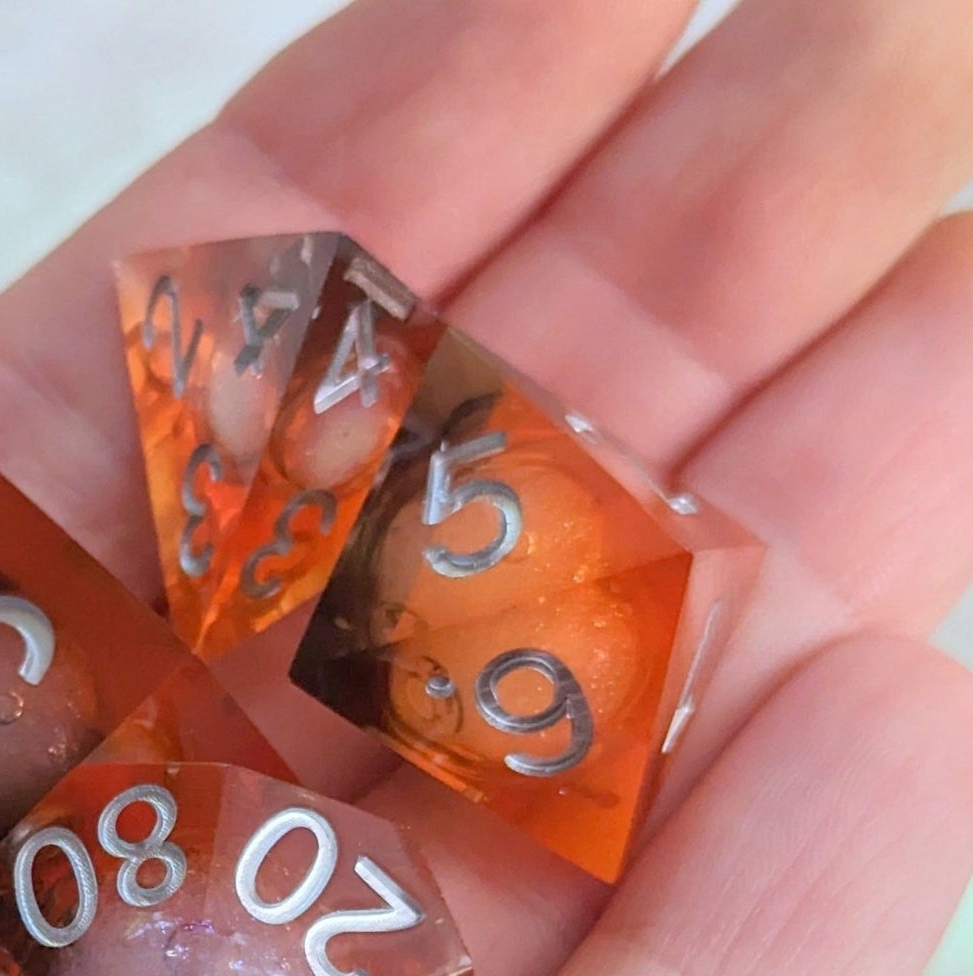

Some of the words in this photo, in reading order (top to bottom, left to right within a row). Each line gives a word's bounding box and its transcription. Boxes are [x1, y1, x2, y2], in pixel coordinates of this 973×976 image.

[313, 299, 393, 414] 4
[180, 443, 223, 577] 3
[240, 489, 337, 600] 3
[421, 431, 523, 578] 5
[13, 783, 187, 948] 80
